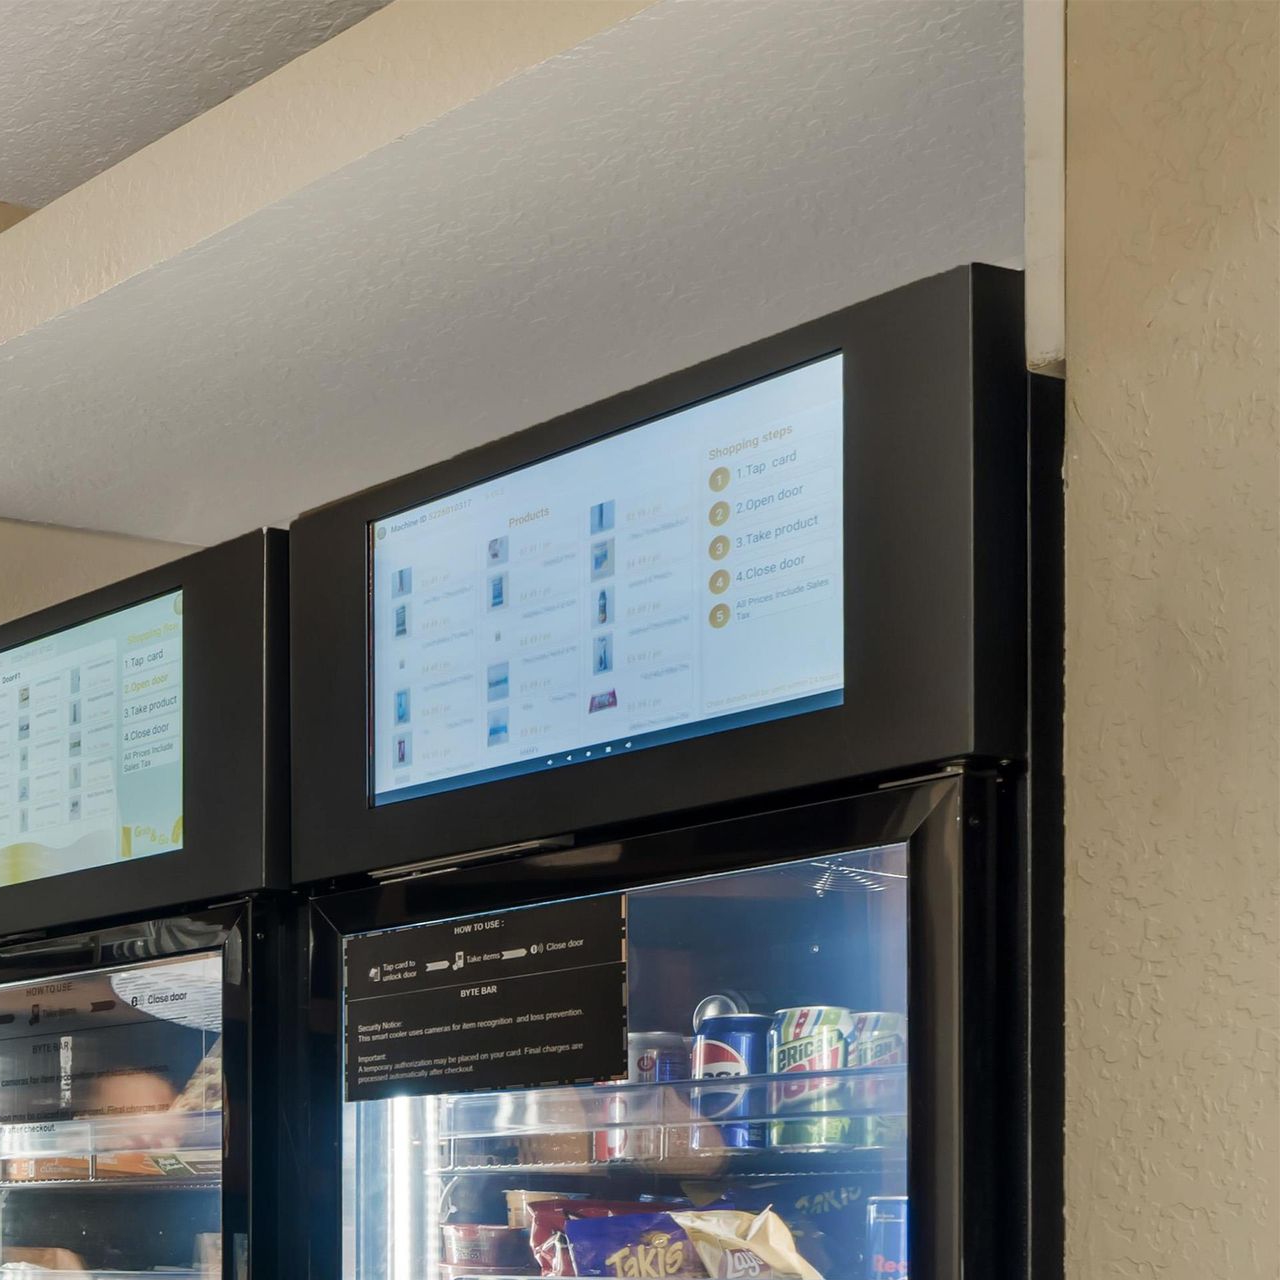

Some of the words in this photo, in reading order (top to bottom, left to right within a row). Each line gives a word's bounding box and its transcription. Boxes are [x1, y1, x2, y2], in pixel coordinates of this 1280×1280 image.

[708, 437, 759, 460] Shopping
[762, 425, 793, 443] steps
[737, 461, 766, 478] 1.Tap
[771, 450, 797, 468] card
[736, 494, 775, 514] 2.Open
[777, 485, 804, 501] door
[390, 518, 419, 533] Machine
[419, 515, 428, 524] ID
[508, 506, 551, 529] Products
[736, 529, 772, 548] 3.Take
[774, 515, 819, 539] product
[736, 563, 777, 582] 4.Close
[779, 555, 806, 570] door
[748, 593, 774, 606] Prices
[775, 584, 805, 599] Include
[806, 577, 830, 591] Sales
[736, 611, 750, 620] Tax
[125, 654, 144, 669] 1.Tap
[146, 649, 164, 662] card
[124, 679, 150, 694] 2.Open
[151, 673, 168, 686] door
[124, 704, 148, 719] 3.Take
[149, 695, 177, 714] product
[124, 728, 151, 742] 4.Close
[152, 722, 169, 735] door
[124, 751, 132, 761] All
[132, 747, 151, 759] Prices
[151, 742, 174, 755] Include
[123, 762, 140, 773] Sales
[141, 759, 151, 768] Tax
[454, 925, 472, 935] HOW
[474, 923, 484, 932] TO
[485, 919, 500, 930] USE
[546, 941, 566, 952] Close
[567, 937, 584, 949] door
[383, 963, 394, 973] Tap
[394, 960, 408, 969] card
[409, 959, 416, 968] to
[466, 954, 482, 964] Take
[482, 951, 501, 962] items
[383, 972, 402, 983] unlock
[402, 969, 417, 979] door
[26, 987, 44, 998] HOW
[44, 985, 54, 994] TO
[147, 993, 168, 1005] Close
[169, 990, 188, 1002] door
[460, 987, 480, 998] BYTE
[480, 985, 498, 996] BAR
[358, 1034, 371, 1043] This
[371, 1032, 388, 1041] smart
[389, 1030, 407, 1039] cooler
[408, 1028, 424, 1037] uses
[424, 1024, 451, 1035] cameras
[452, 1022, 461, 1032] for
[462, 1020, 476, 1030] item
[477, 1017, 513, 1029] recognition
[516, 1013, 529, 1023] and
[530, 1012, 544, 1021] loss
[358, 1023, 381, 1034] Security
[32, 1043, 52, 1055] BYTE
[52, 1041, 70, 1053] BAR
[363, 1063, 393, 1073] temporary
[393, 1059, 433, 1070] authorization
[433, 1056, 447, 1066] may
[448, 1055, 456, 1064] be
[457, 1052, 479, 1063] placed
[480, 1052, 489, 1061] on
[490, 1050, 505, 1060] your
[524, 1046, 541, 1056] Final
[542, 1043, 570, 1054] charges
[571, 1042, 584, 1050] are
[358, 1073, 389, 1085] processed
[389, 1069, 428, 1080] automatically
[429, 1067, 443, 1077] after
